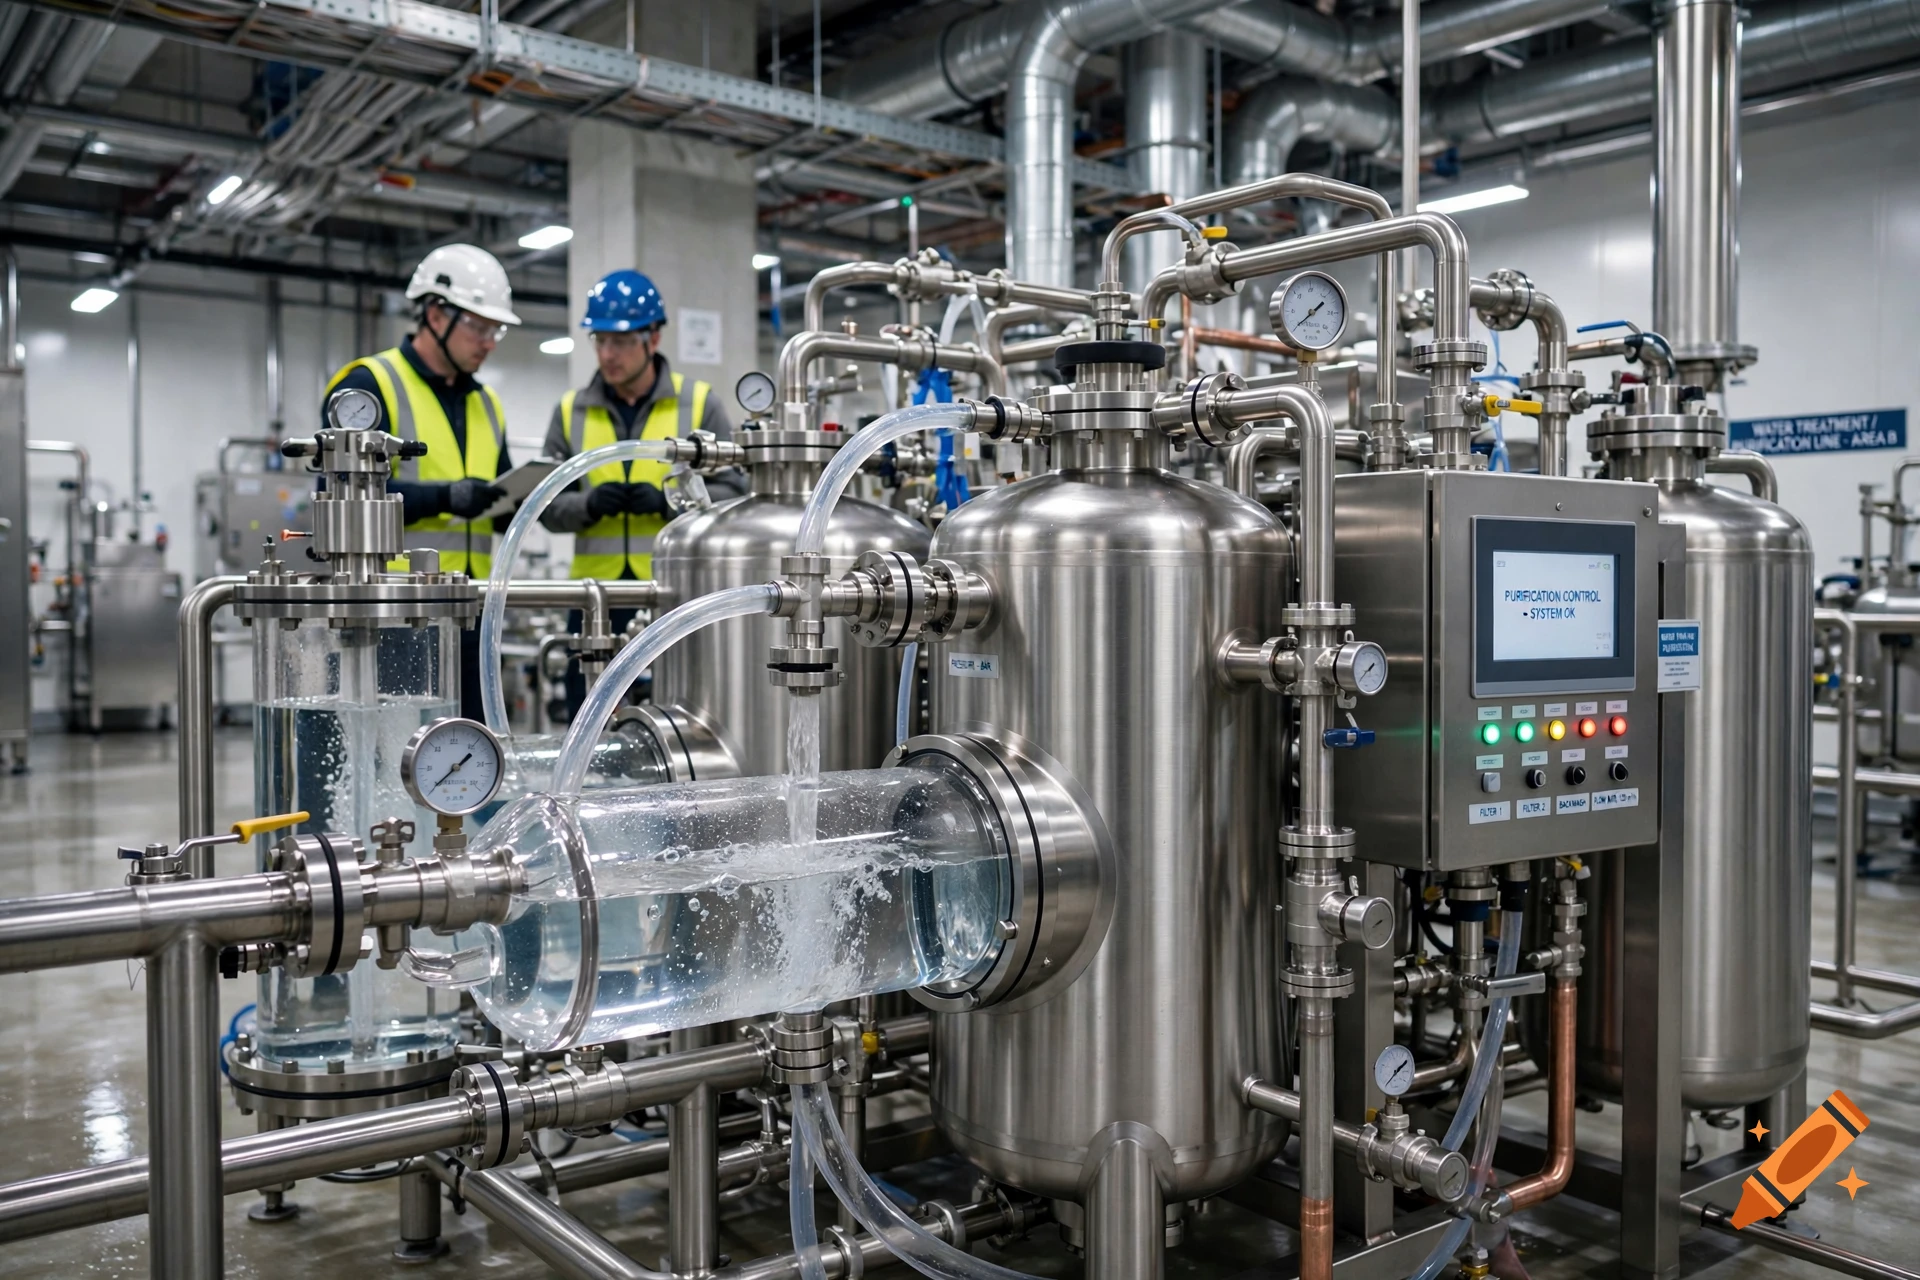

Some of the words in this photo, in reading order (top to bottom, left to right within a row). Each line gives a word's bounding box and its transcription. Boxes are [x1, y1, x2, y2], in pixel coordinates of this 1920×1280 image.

[1752, 420, 1795, 436] WATER
[1796, 416, 1868, 434] TREATMENT
[1814, 433, 1841, 450] LINE
[1850, 430, 1886, 447] AREA
[1504, 590, 1561, 602] PURIFICATION
[1563, 590, 1601, 602] CONTROL
[1530, 607, 1562, 620] SYSTEM
[1564, 607, 1576, 619] OK
[1523, 803, 1541, 813] FILTER
